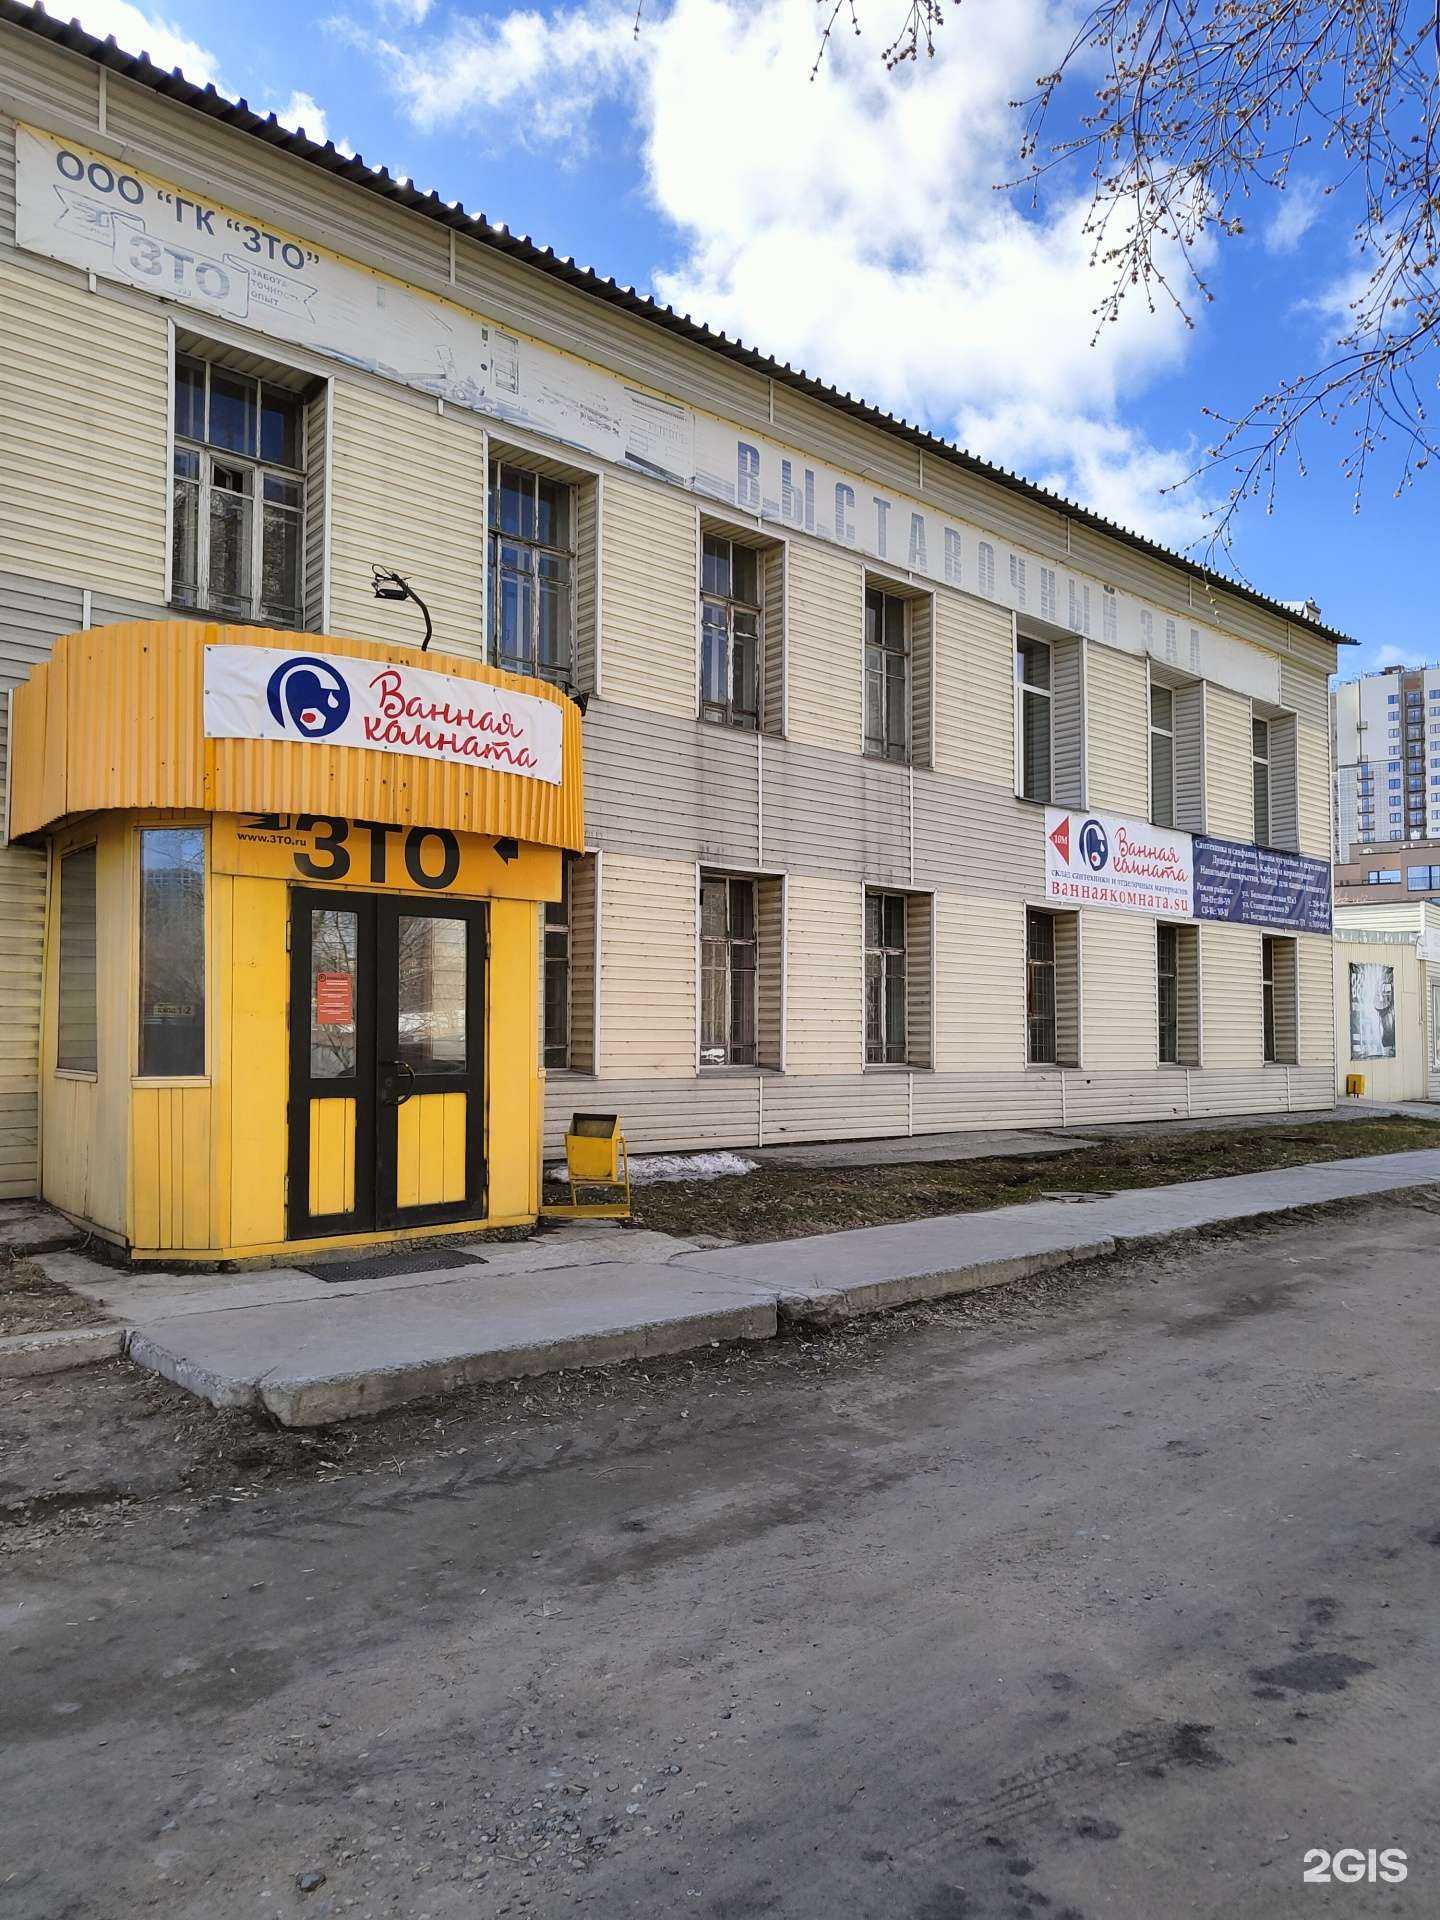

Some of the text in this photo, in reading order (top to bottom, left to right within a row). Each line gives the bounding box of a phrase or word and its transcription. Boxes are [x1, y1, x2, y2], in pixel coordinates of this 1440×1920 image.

[57, 151, 144, 204] ООО
[369, 670, 524, 739] Ванная
[1114, 827, 1180, 864] Ванная
